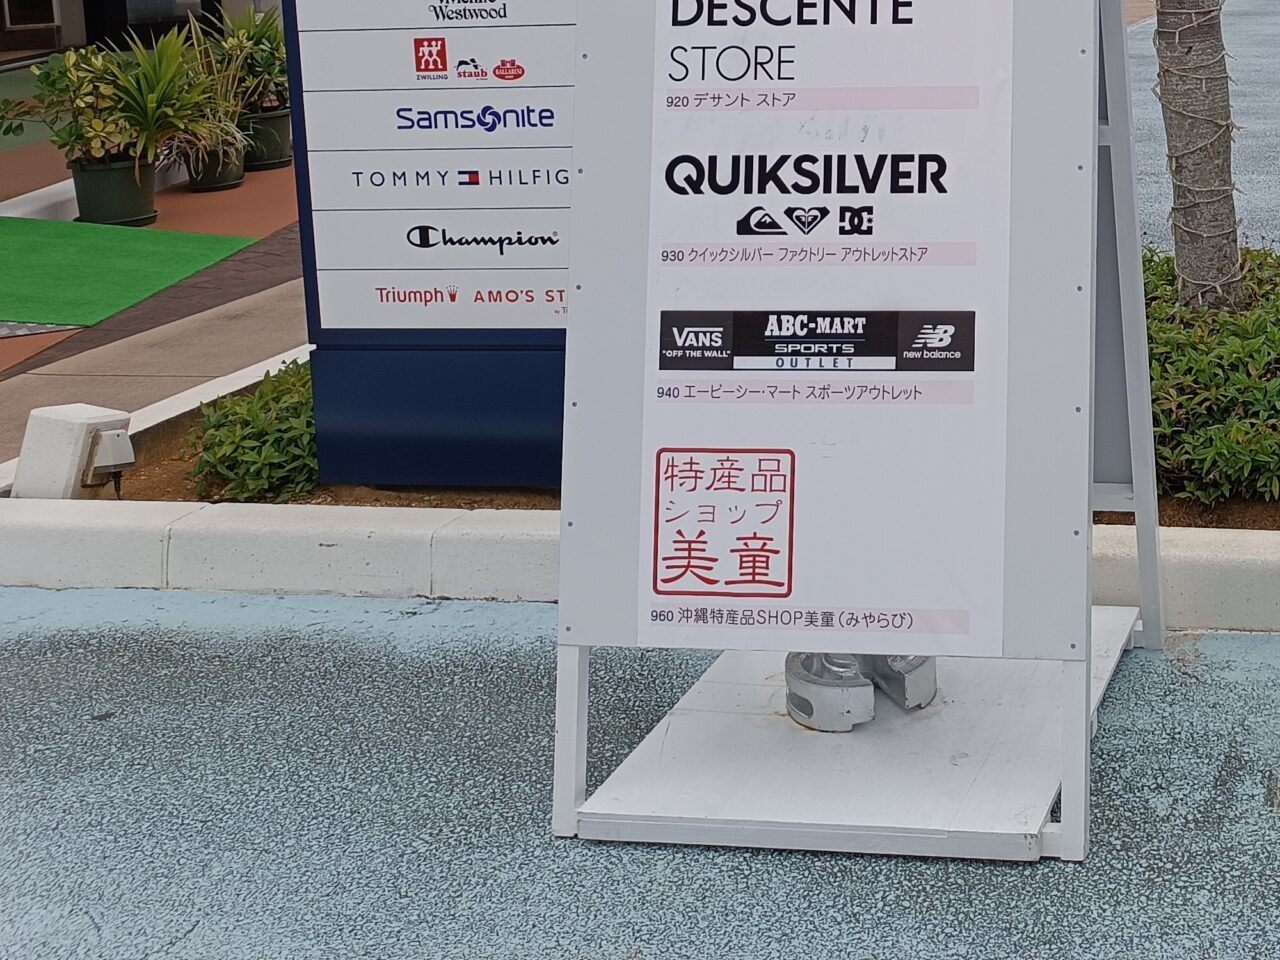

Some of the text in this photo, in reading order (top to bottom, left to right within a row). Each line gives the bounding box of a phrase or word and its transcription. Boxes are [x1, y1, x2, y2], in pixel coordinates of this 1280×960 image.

[427, 3, 508, 22] Westwood
[667, 44, 796, 82] STORE
[416, 73, 449, 81] ZWILLING
[457, 68, 488, 79] staub
[666, 92, 796, 108] 920 デサント ストア
[396, 105, 555, 133] Samsonite
[351, 170, 450, 188] TOMMY
[664, 152, 949, 196] QUIKSILVER
[661, 247, 928, 262] 930 クイックシルバー ファクトリー アウトレットストア
[374, 286, 445, 307] Triumph
[473, 289, 536, 303] AMO'S
[764, 314, 867, 336] ABC-MART
[671, 327, 724, 347] VANS
[685, 349, 703, 358] THE
[774, 343, 855, 354] SPORTS
[903, 349, 962, 359] new balance
[775, 357, 855, 369] OUTLET
[656, 386, 680, 399] 940
[805, 384, 922, 400] スポーツアウトレット
[663, 456, 788, 494] 特産品
[664, 499, 783, 525] ショップ
[660, 529, 786, 588] 美童
[650, 610, 674, 623] 960
